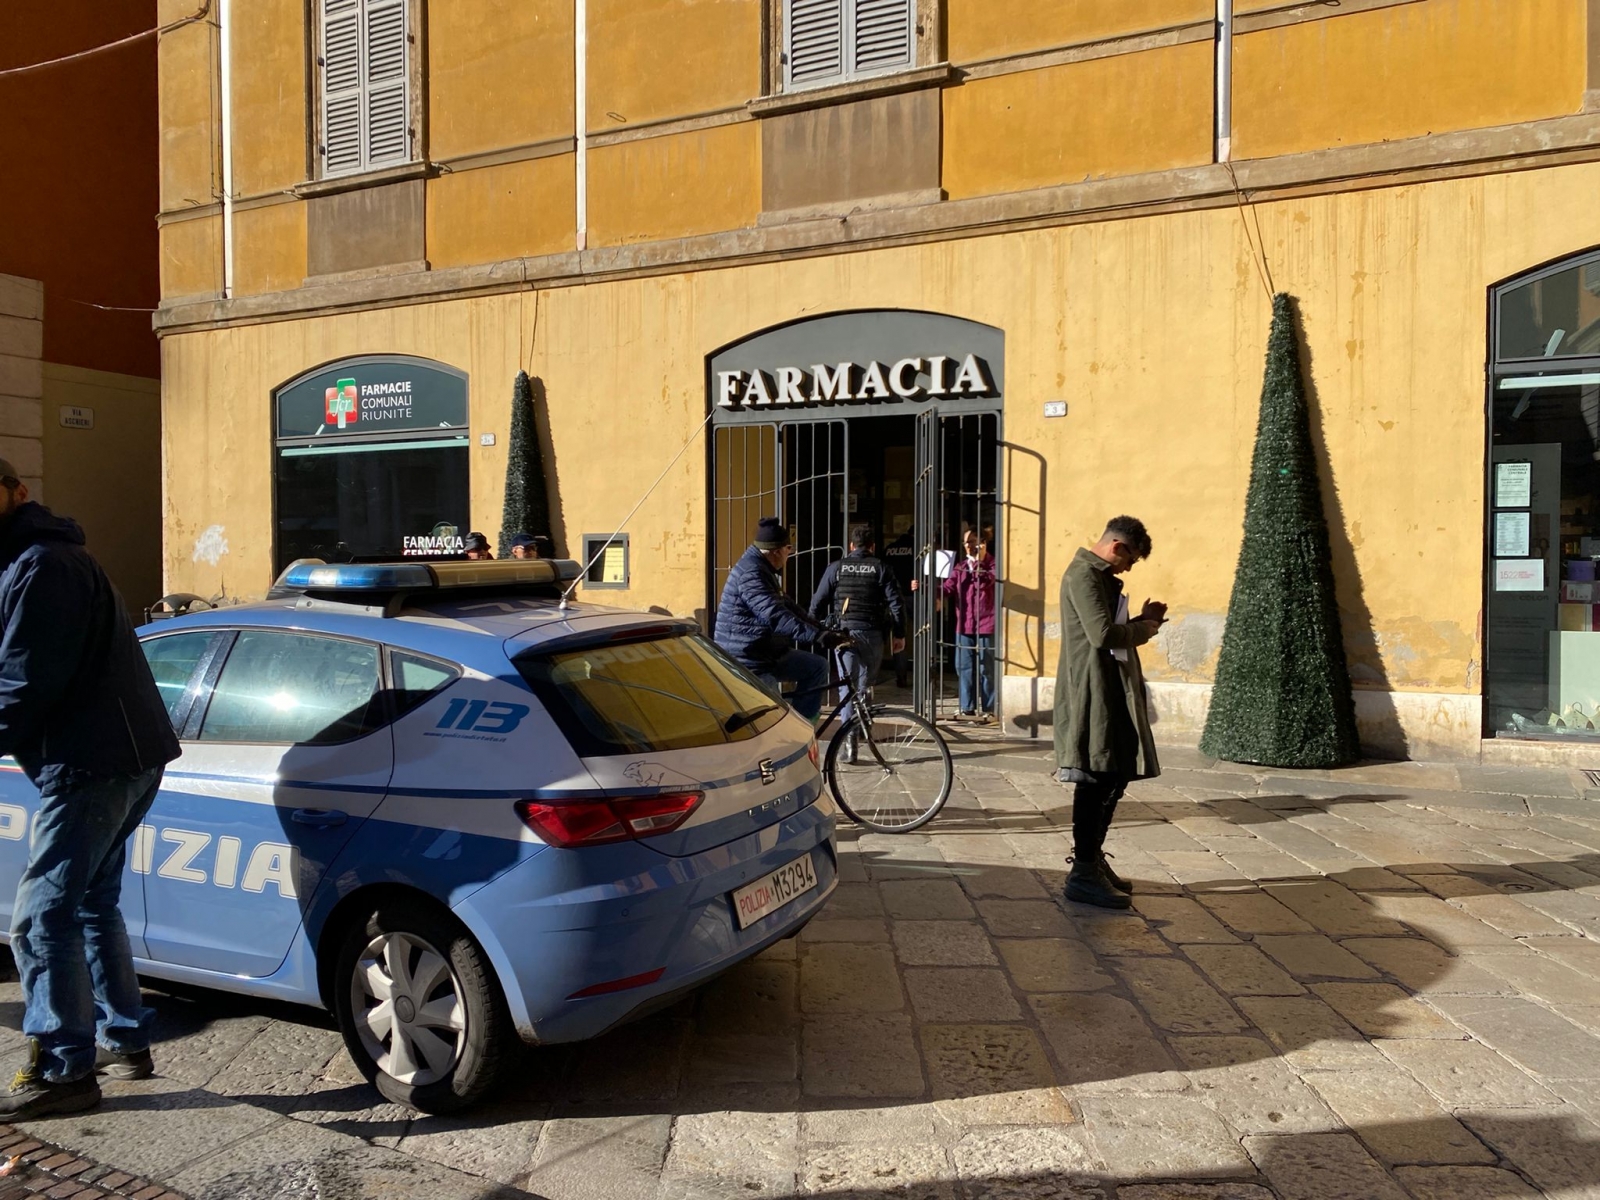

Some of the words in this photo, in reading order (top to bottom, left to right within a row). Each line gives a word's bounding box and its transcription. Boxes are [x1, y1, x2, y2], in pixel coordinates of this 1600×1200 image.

[717, 353, 989, 407] FARMACIA
[361, 381, 411, 396] FARMACIE
[361, 395, 412, 409] COMUNALI
[71, 408, 82, 416] VIA
[361, 408, 412, 421] RIUNITE
[403, 536, 464, 549] FARMACIA
[885, 547, 913, 556] POLIZIA
[841, 564, 876, 574] POLIZIA
[1500, 571, 1518, 579] 1522
[435, 698, 530, 734] 113
[0, 803, 300, 900] PIZIA
[740, 886, 772, 917] POLIZIA
[772, 858, 813, 902] M3294
